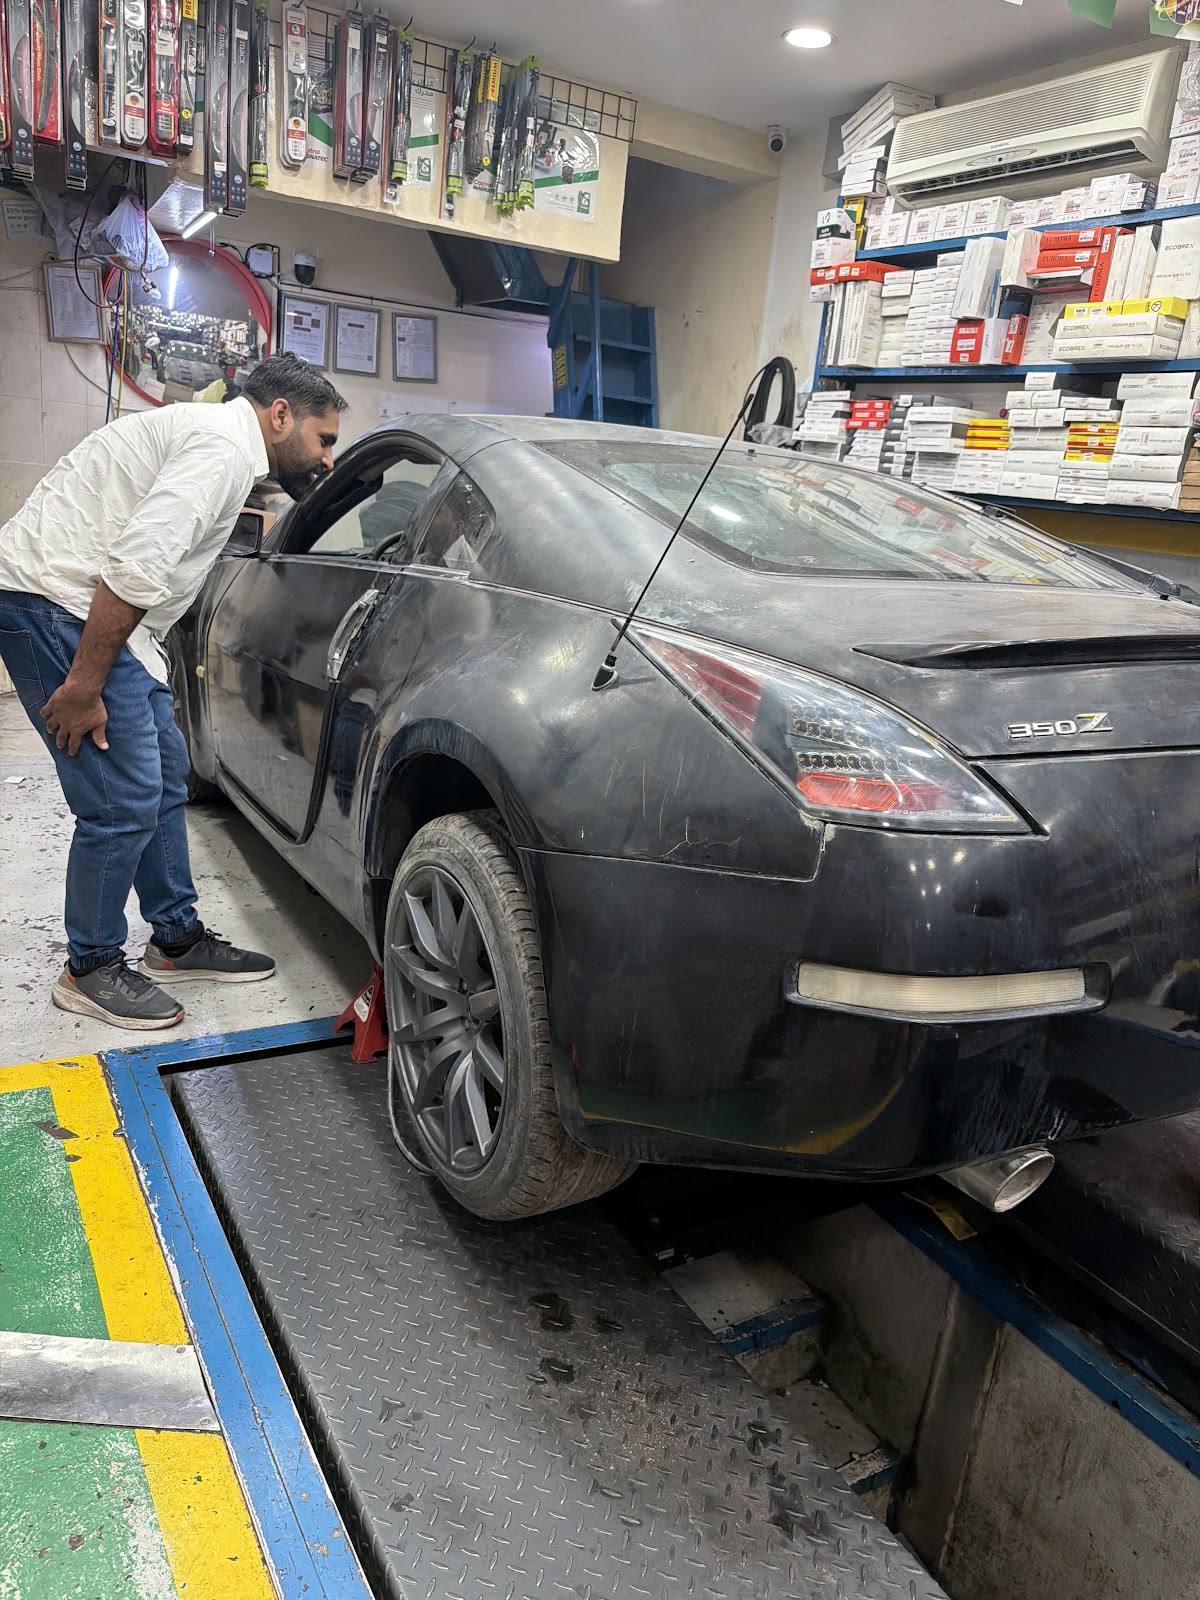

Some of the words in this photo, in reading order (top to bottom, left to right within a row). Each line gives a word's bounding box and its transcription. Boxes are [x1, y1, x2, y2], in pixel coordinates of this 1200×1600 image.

[491, 62, 499, 95] PREMIUM
[307, 154, 329, 162] GNATEC
[1164, 242, 1196, 251] ECOBREX
[1164, 323, 1181, 331] ECOBREX
[1160, 344, 1177, 352] ECOBREX
[1004, 712, 1114, 740] 350Z
